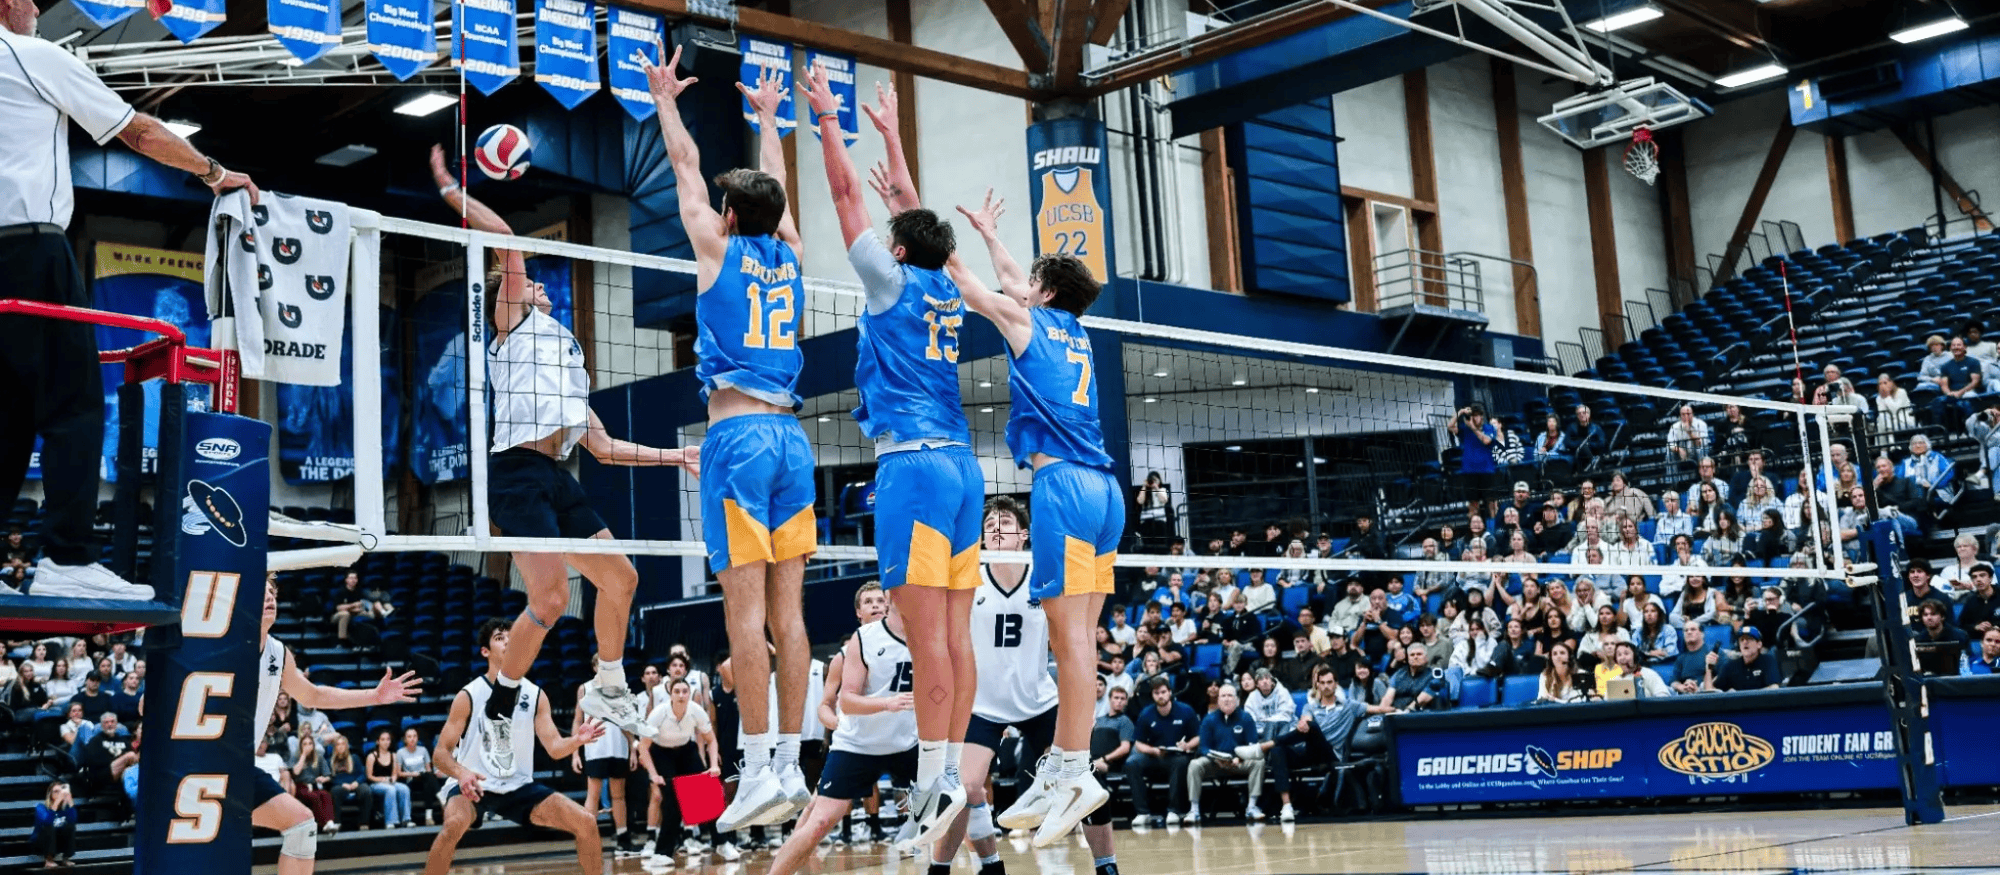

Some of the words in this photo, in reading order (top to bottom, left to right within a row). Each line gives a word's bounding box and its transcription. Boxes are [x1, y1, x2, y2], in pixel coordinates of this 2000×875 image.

[369, 12, 432, 33] Championships
[384, 4, 398, 17] Big
[402, 7, 419, 19] West
[474, 23, 499, 35] NCAA
[380, 43, 423, 62] 2000
[465, 58, 508, 76] 2000
[1795, 79, 1812, 109] 1
[1033, 146, 1100, 170] SHAW
[1046, 203, 1093, 226] UCSB
[1055, 231, 1087, 255] 22
[112, 251, 153, 265] MARK
[159, 257, 204, 271] FRENC
[740, 255, 797, 284] BRUINS
[472, 294, 483, 343] Schelde
[743, 282, 795, 350] 12
[923, 310, 963, 363] 15
[264, 339, 327, 359] ORADE
[1066, 347, 1092, 408] 7
[299, 465, 329, 480] THE
[305, 456, 313, 465] A
[994, 613, 1023, 648] 13
[1685, 724, 1745, 755] GAUCHO
[1782, 733, 1841, 756] STUDENT
[1844, 732, 1870, 753] FAN
[1417, 753, 1523, 777] GAUCHOS
[1556, 748, 1622, 770] SHOP
[1661, 743, 1771, 773] NATION
[1812, 754, 1829, 762] TEAM
[1830, 753, 1854, 761] ONLINE
